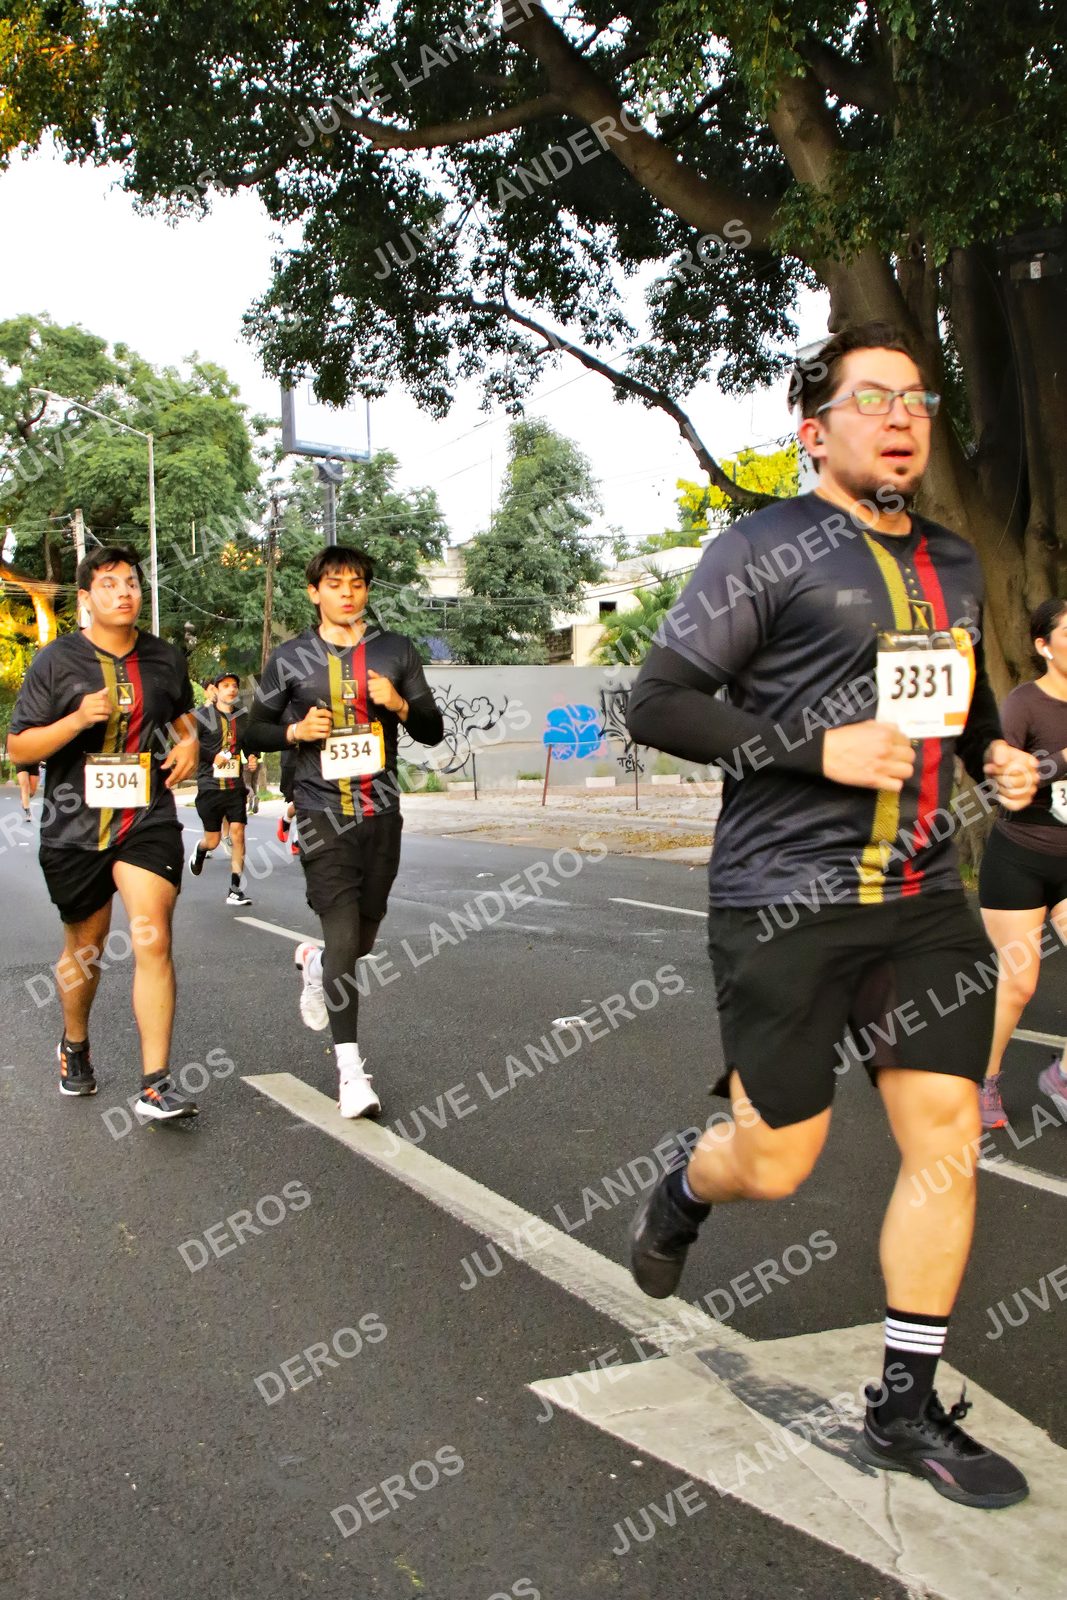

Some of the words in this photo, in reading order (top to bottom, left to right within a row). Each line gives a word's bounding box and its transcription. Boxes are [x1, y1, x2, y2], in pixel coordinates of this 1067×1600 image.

[891, 663, 953, 700] 3331
[330, 740, 371, 761] 5334
[95, 772, 138, 789] 5304
